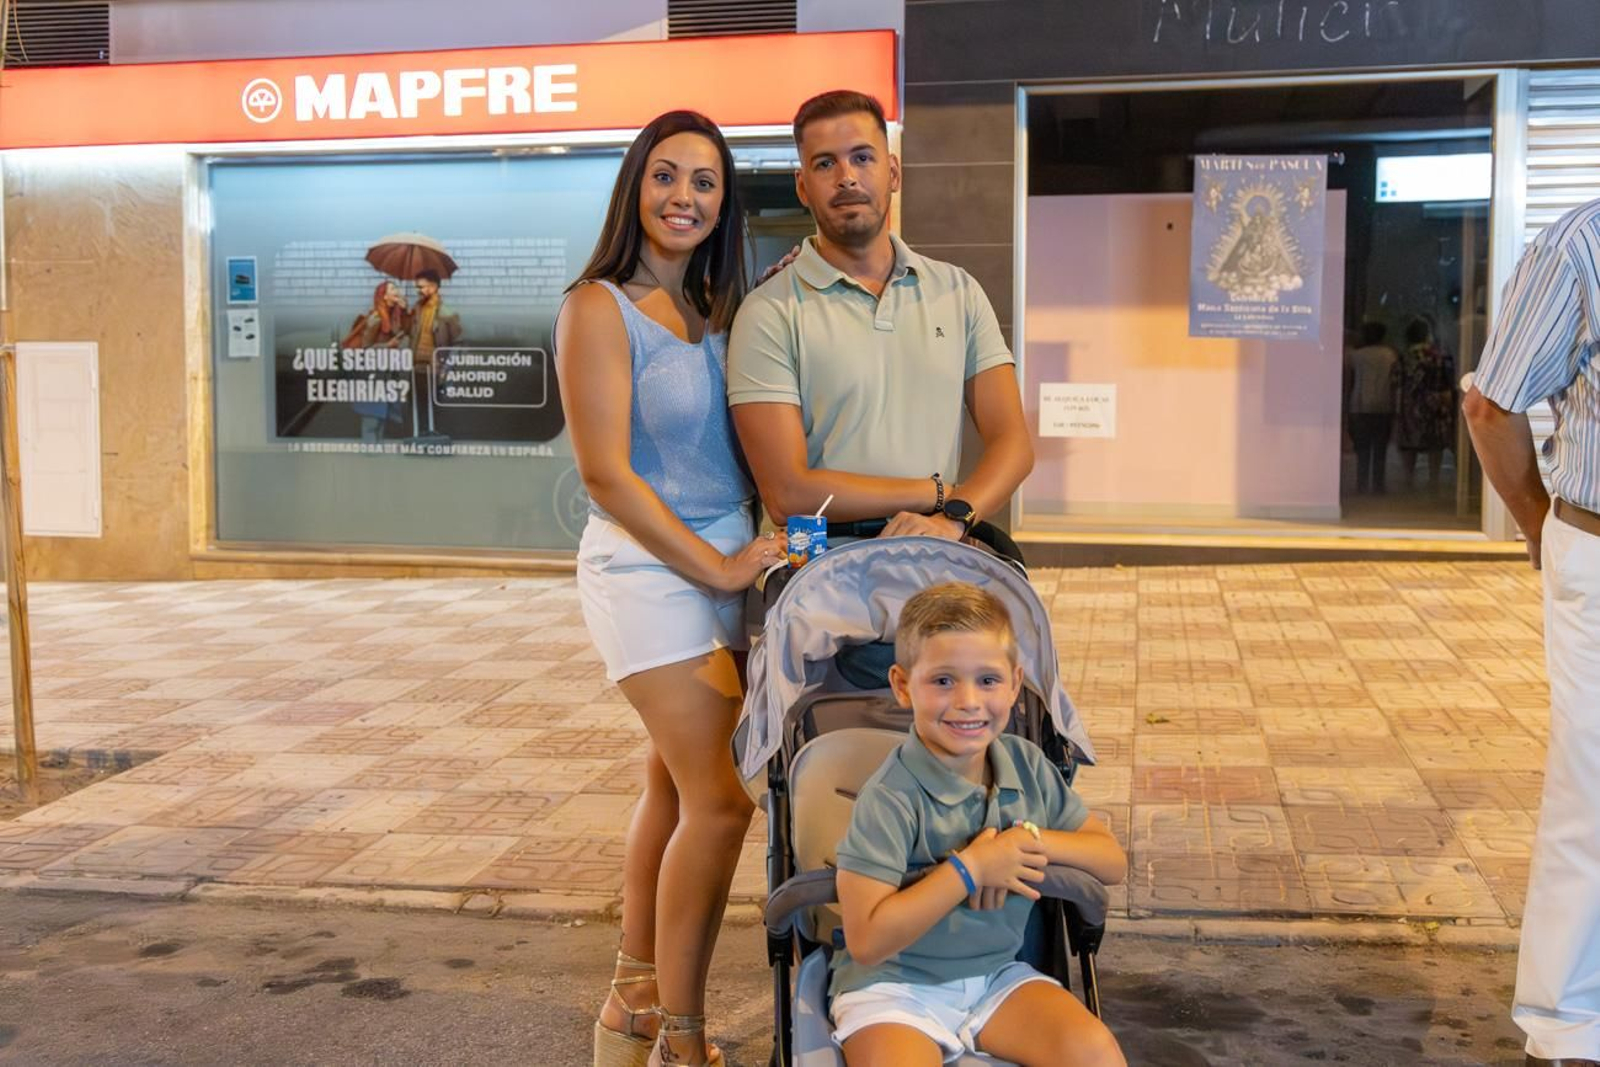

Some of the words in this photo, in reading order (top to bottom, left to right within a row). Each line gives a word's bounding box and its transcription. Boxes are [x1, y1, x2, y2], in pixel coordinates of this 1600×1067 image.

[294, 64, 577, 121] MAPFRE
[292, 342, 339, 375] ¿QUÉ
[342, 348, 413, 371] SEGURO
[446, 352, 532, 367] JUBILACIÓN
[446, 370, 507, 383] AHORRO
[307, 373, 410, 403] ELEGIRÍAS?
[446, 386, 494, 398] SALUD
[400, 442, 425, 455] MÁS
